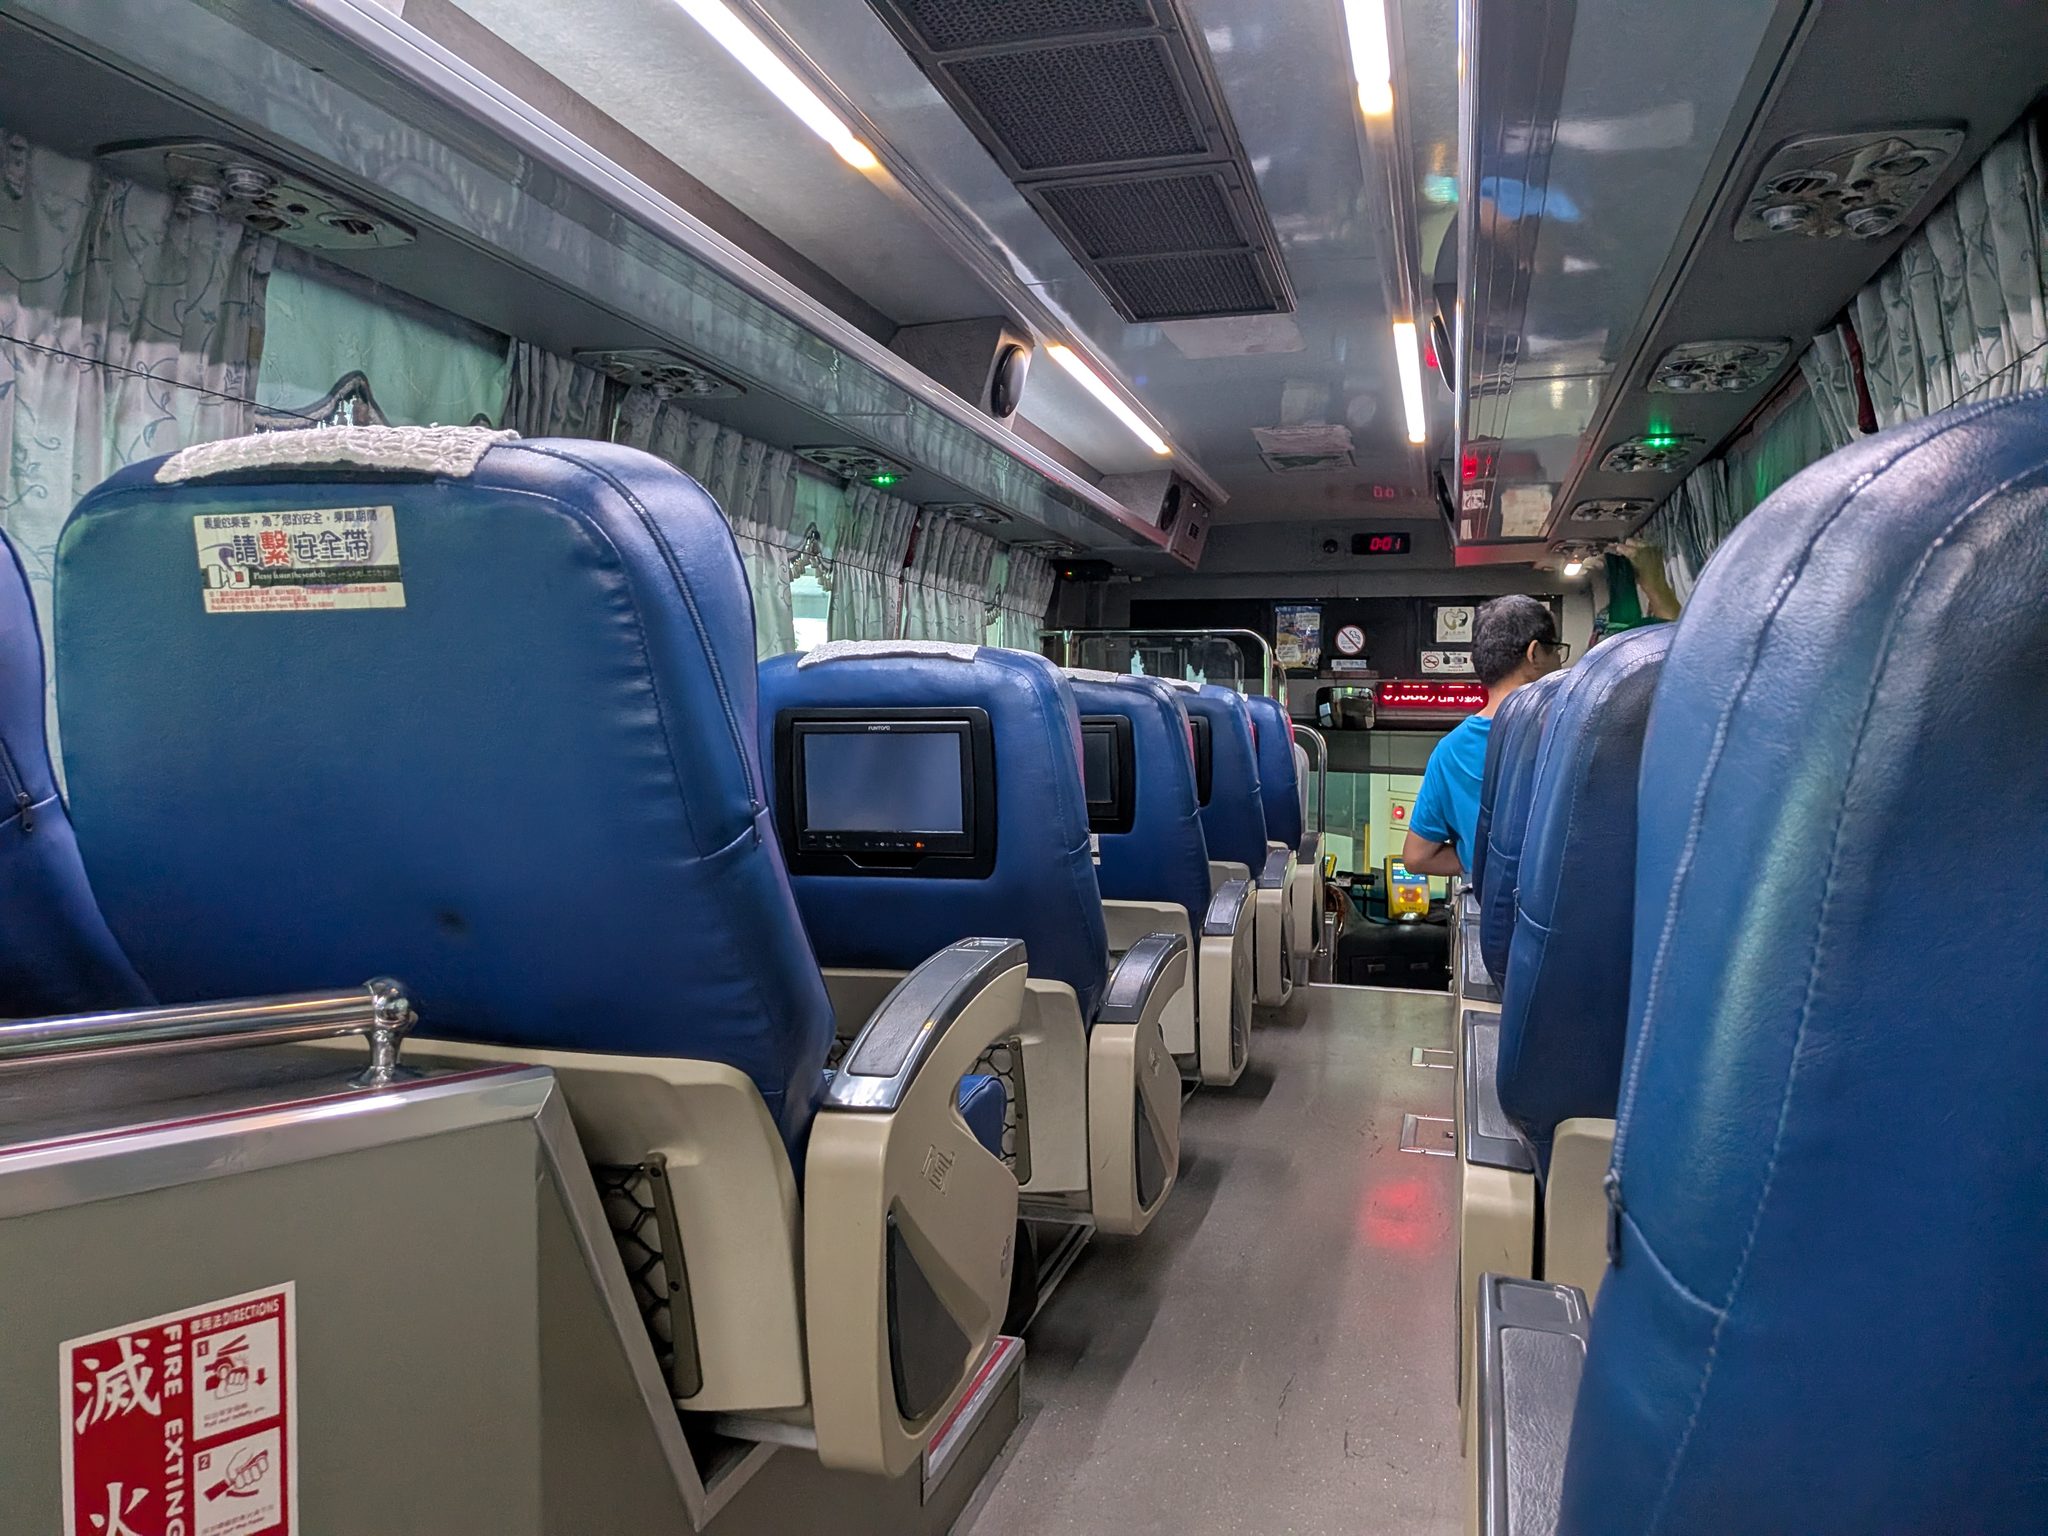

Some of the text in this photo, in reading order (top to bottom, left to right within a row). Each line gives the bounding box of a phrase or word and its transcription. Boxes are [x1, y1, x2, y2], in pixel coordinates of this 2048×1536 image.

[233, 529, 369, 566] 請繫安全帶
[222, 1298, 280, 1326] DIRECTIONS
[163, 1324, 186, 1536] FIRE EXTING
